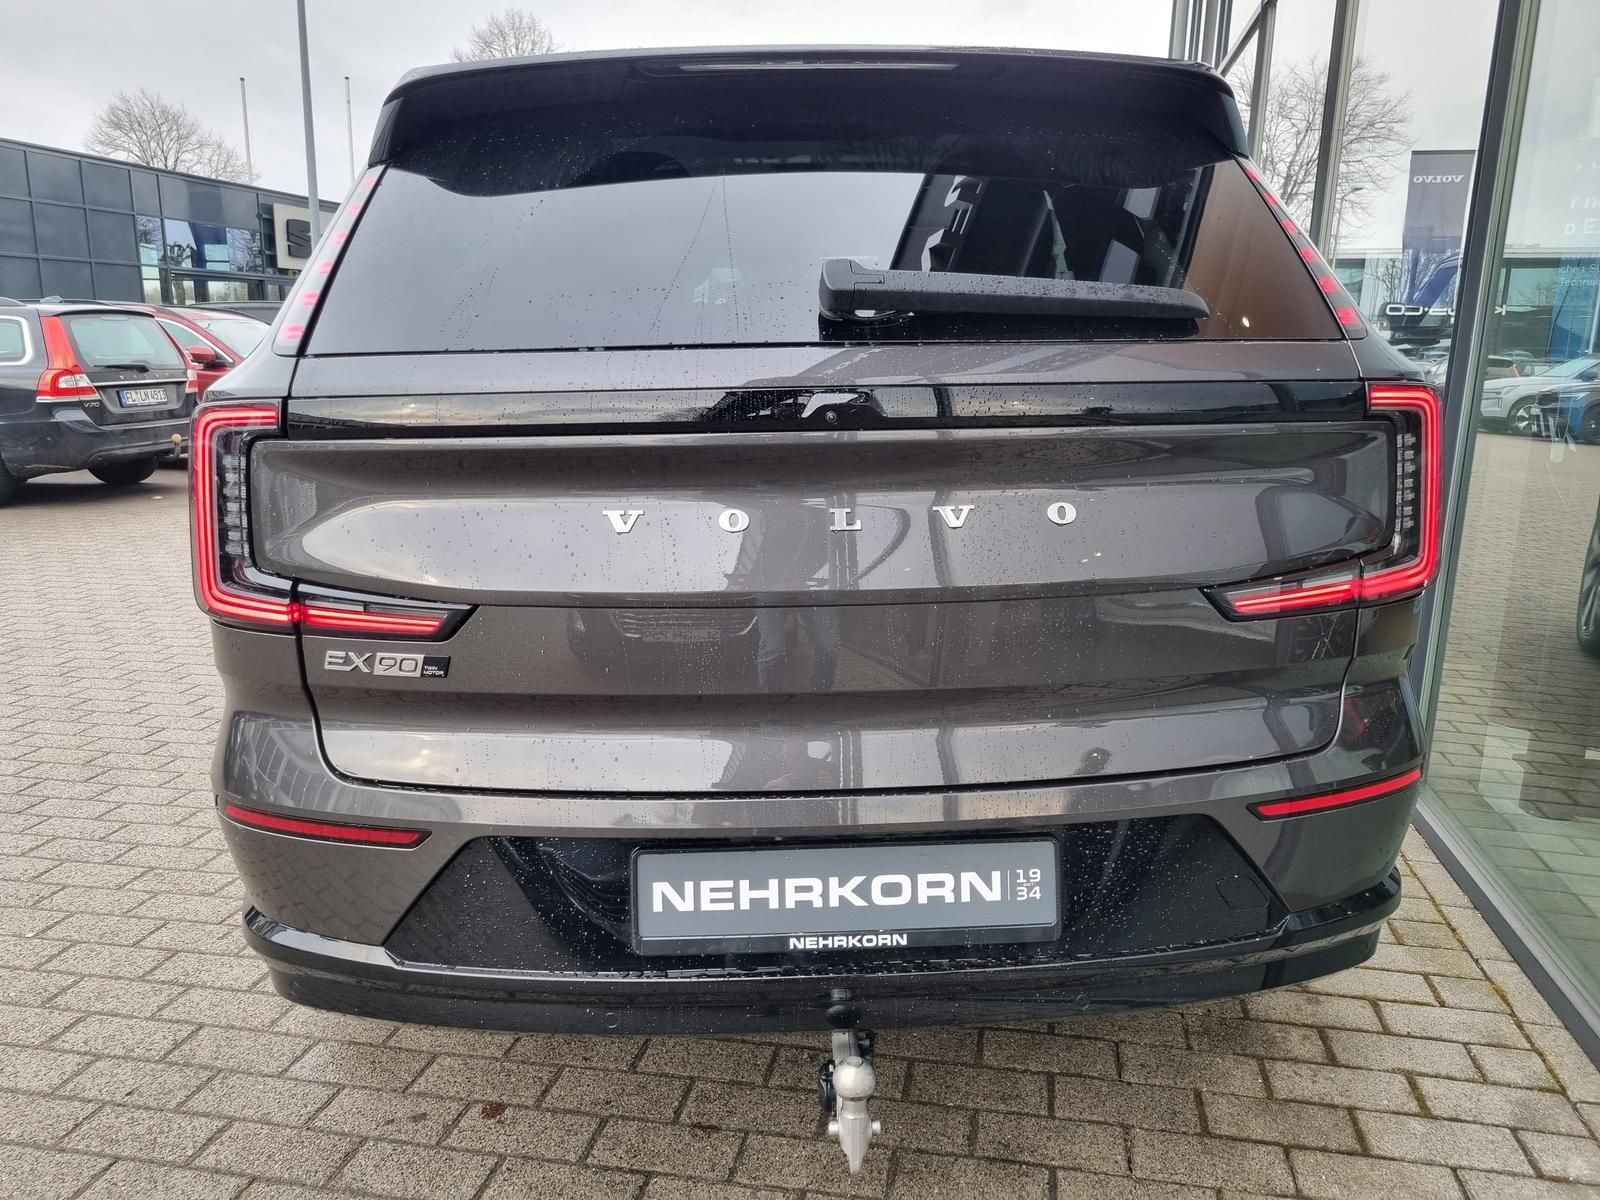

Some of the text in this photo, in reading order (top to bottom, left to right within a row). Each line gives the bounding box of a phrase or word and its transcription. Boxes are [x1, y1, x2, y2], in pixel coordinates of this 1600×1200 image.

[125, 392, 136, 403] FL
[602, 501, 1078, 534] VOLVO
[1016, 868, 1041, 883] 19
[651, 870, 1002, 913] NEHRKORN
[1016, 886, 1042, 901] 34
[789, 933, 909, 950] NEHRKORN
